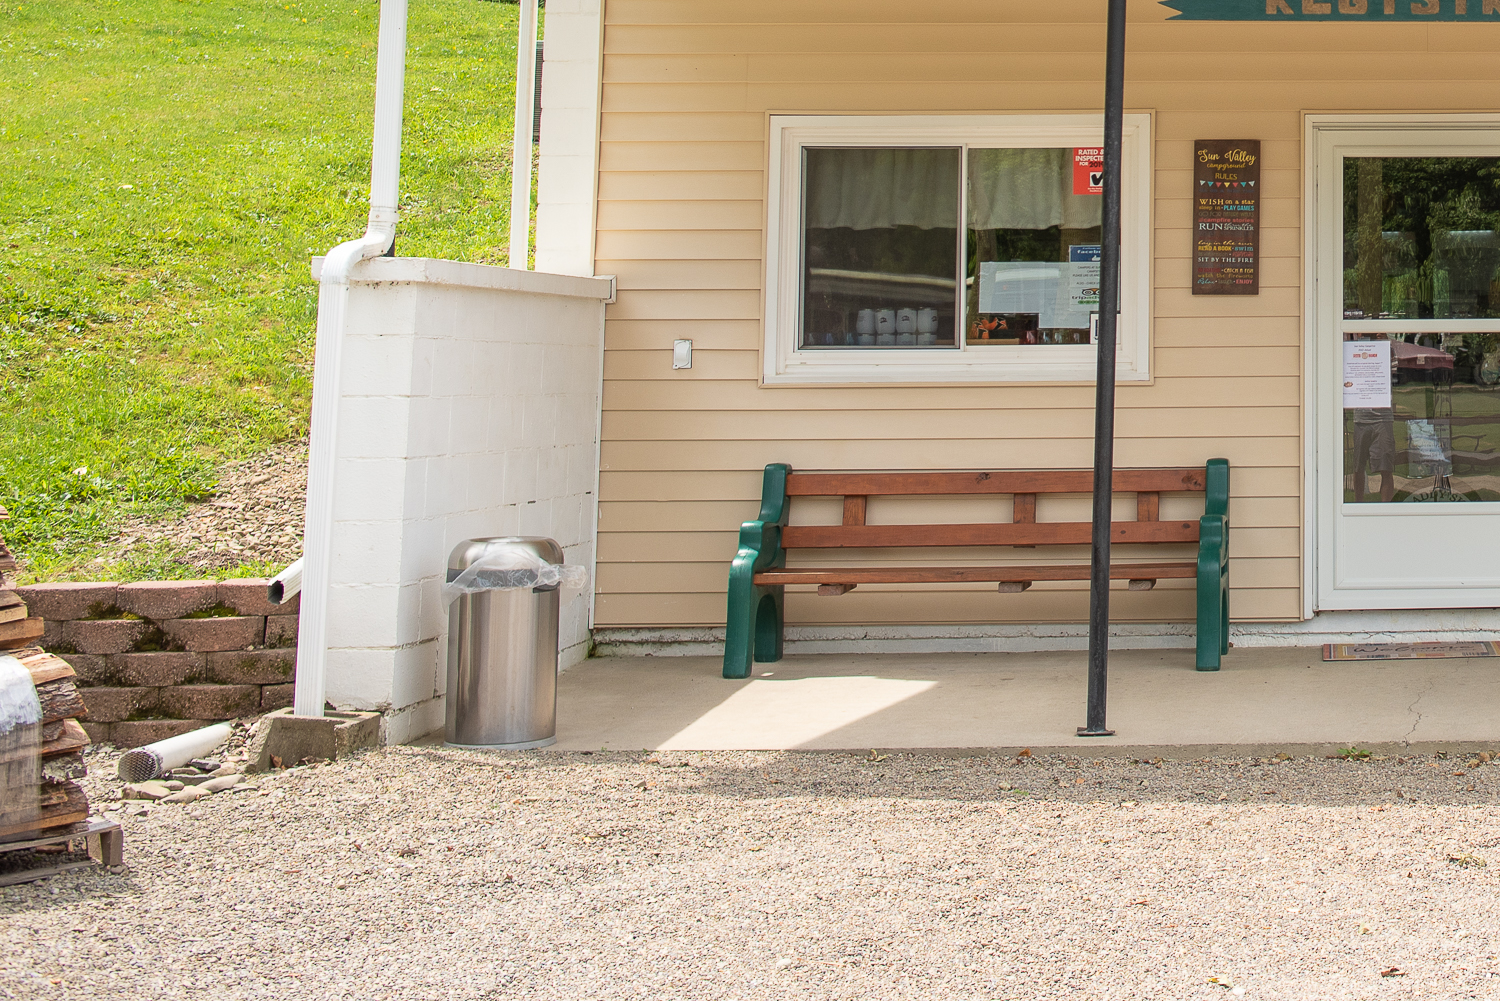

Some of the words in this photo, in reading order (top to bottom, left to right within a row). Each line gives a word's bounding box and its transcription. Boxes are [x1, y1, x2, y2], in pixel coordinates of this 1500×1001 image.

[1198, 149, 1220, 162] Sun
[1224, 149, 1256, 166] Valley
[1207, 163, 1246, 171] campground
